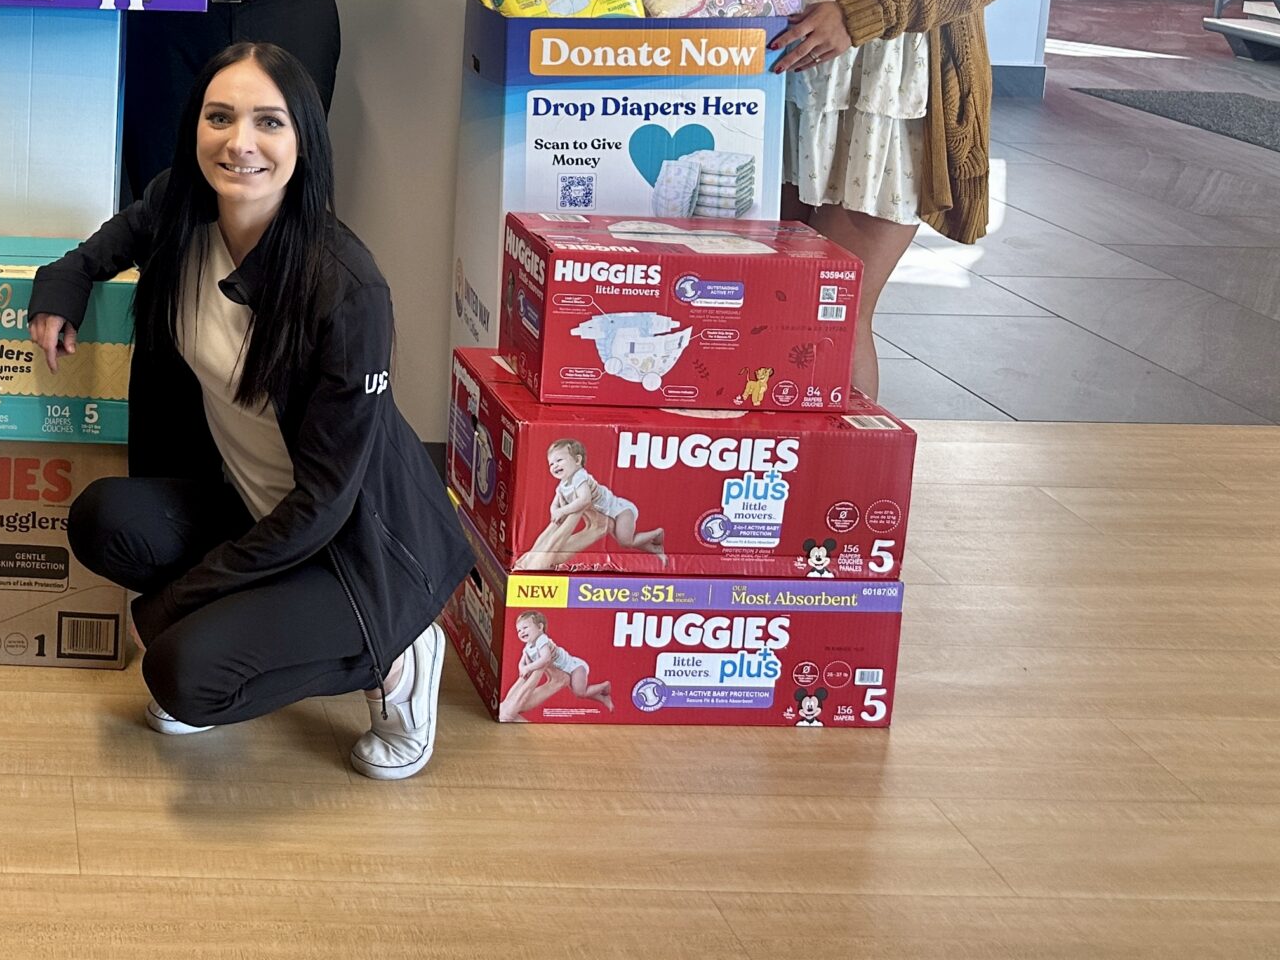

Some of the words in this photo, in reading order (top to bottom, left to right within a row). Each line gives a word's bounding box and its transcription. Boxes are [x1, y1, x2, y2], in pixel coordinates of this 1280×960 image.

[541, 38, 672, 67] Donate
[680, 38, 757, 67] Now
[532, 97, 595, 121] Drop
[601, 96, 696, 121] Diapers
[703, 97, 758, 116] Here
[534, 138, 569, 150] Scan
[573, 140, 588, 150] to
[591, 138, 622, 150] Give
[552, 154, 600, 169] Money
[505, 224, 546, 286] HUGGIES
[554, 259, 662, 285] HUGGIES
[595, 285, 620, 295] little
[622, 287, 660, 297] movers
[806, 386, 821, 397] 84
[830, 386, 842, 403] 6
[46, 405, 70, 417] 104
[84, 403, 99, 424] 5
[41, 424, 74, 433] COUCHES
[617, 431, 800, 472] HUGGIES
[742, 502, 767, 511] little
[734, 512, 773, 520] movers
[843, 544, 859, 553] 156
[15, 552, 46, 561] GENTLE
[868, 539, 895, 573] 5
[15, 561, 65, 571] PROTECTION
[517, 585, 558, 599] NEW
[578, 583, 630, 602] Save
[641, 584, 675, 603] $51
[731, 592, 771, 605] Most
[774, 592, 858, 606] Absorbent
[613, 611, 791, 650] HUGGIES
[34, 634, 46, 657] 1
[673, 656, 702, 667] little
[719, 650, 779, 683] plus
[664, 668, 710, 678] movers
[836, 705, 853, 714] 156
[860, 688, 887, 722] 5
